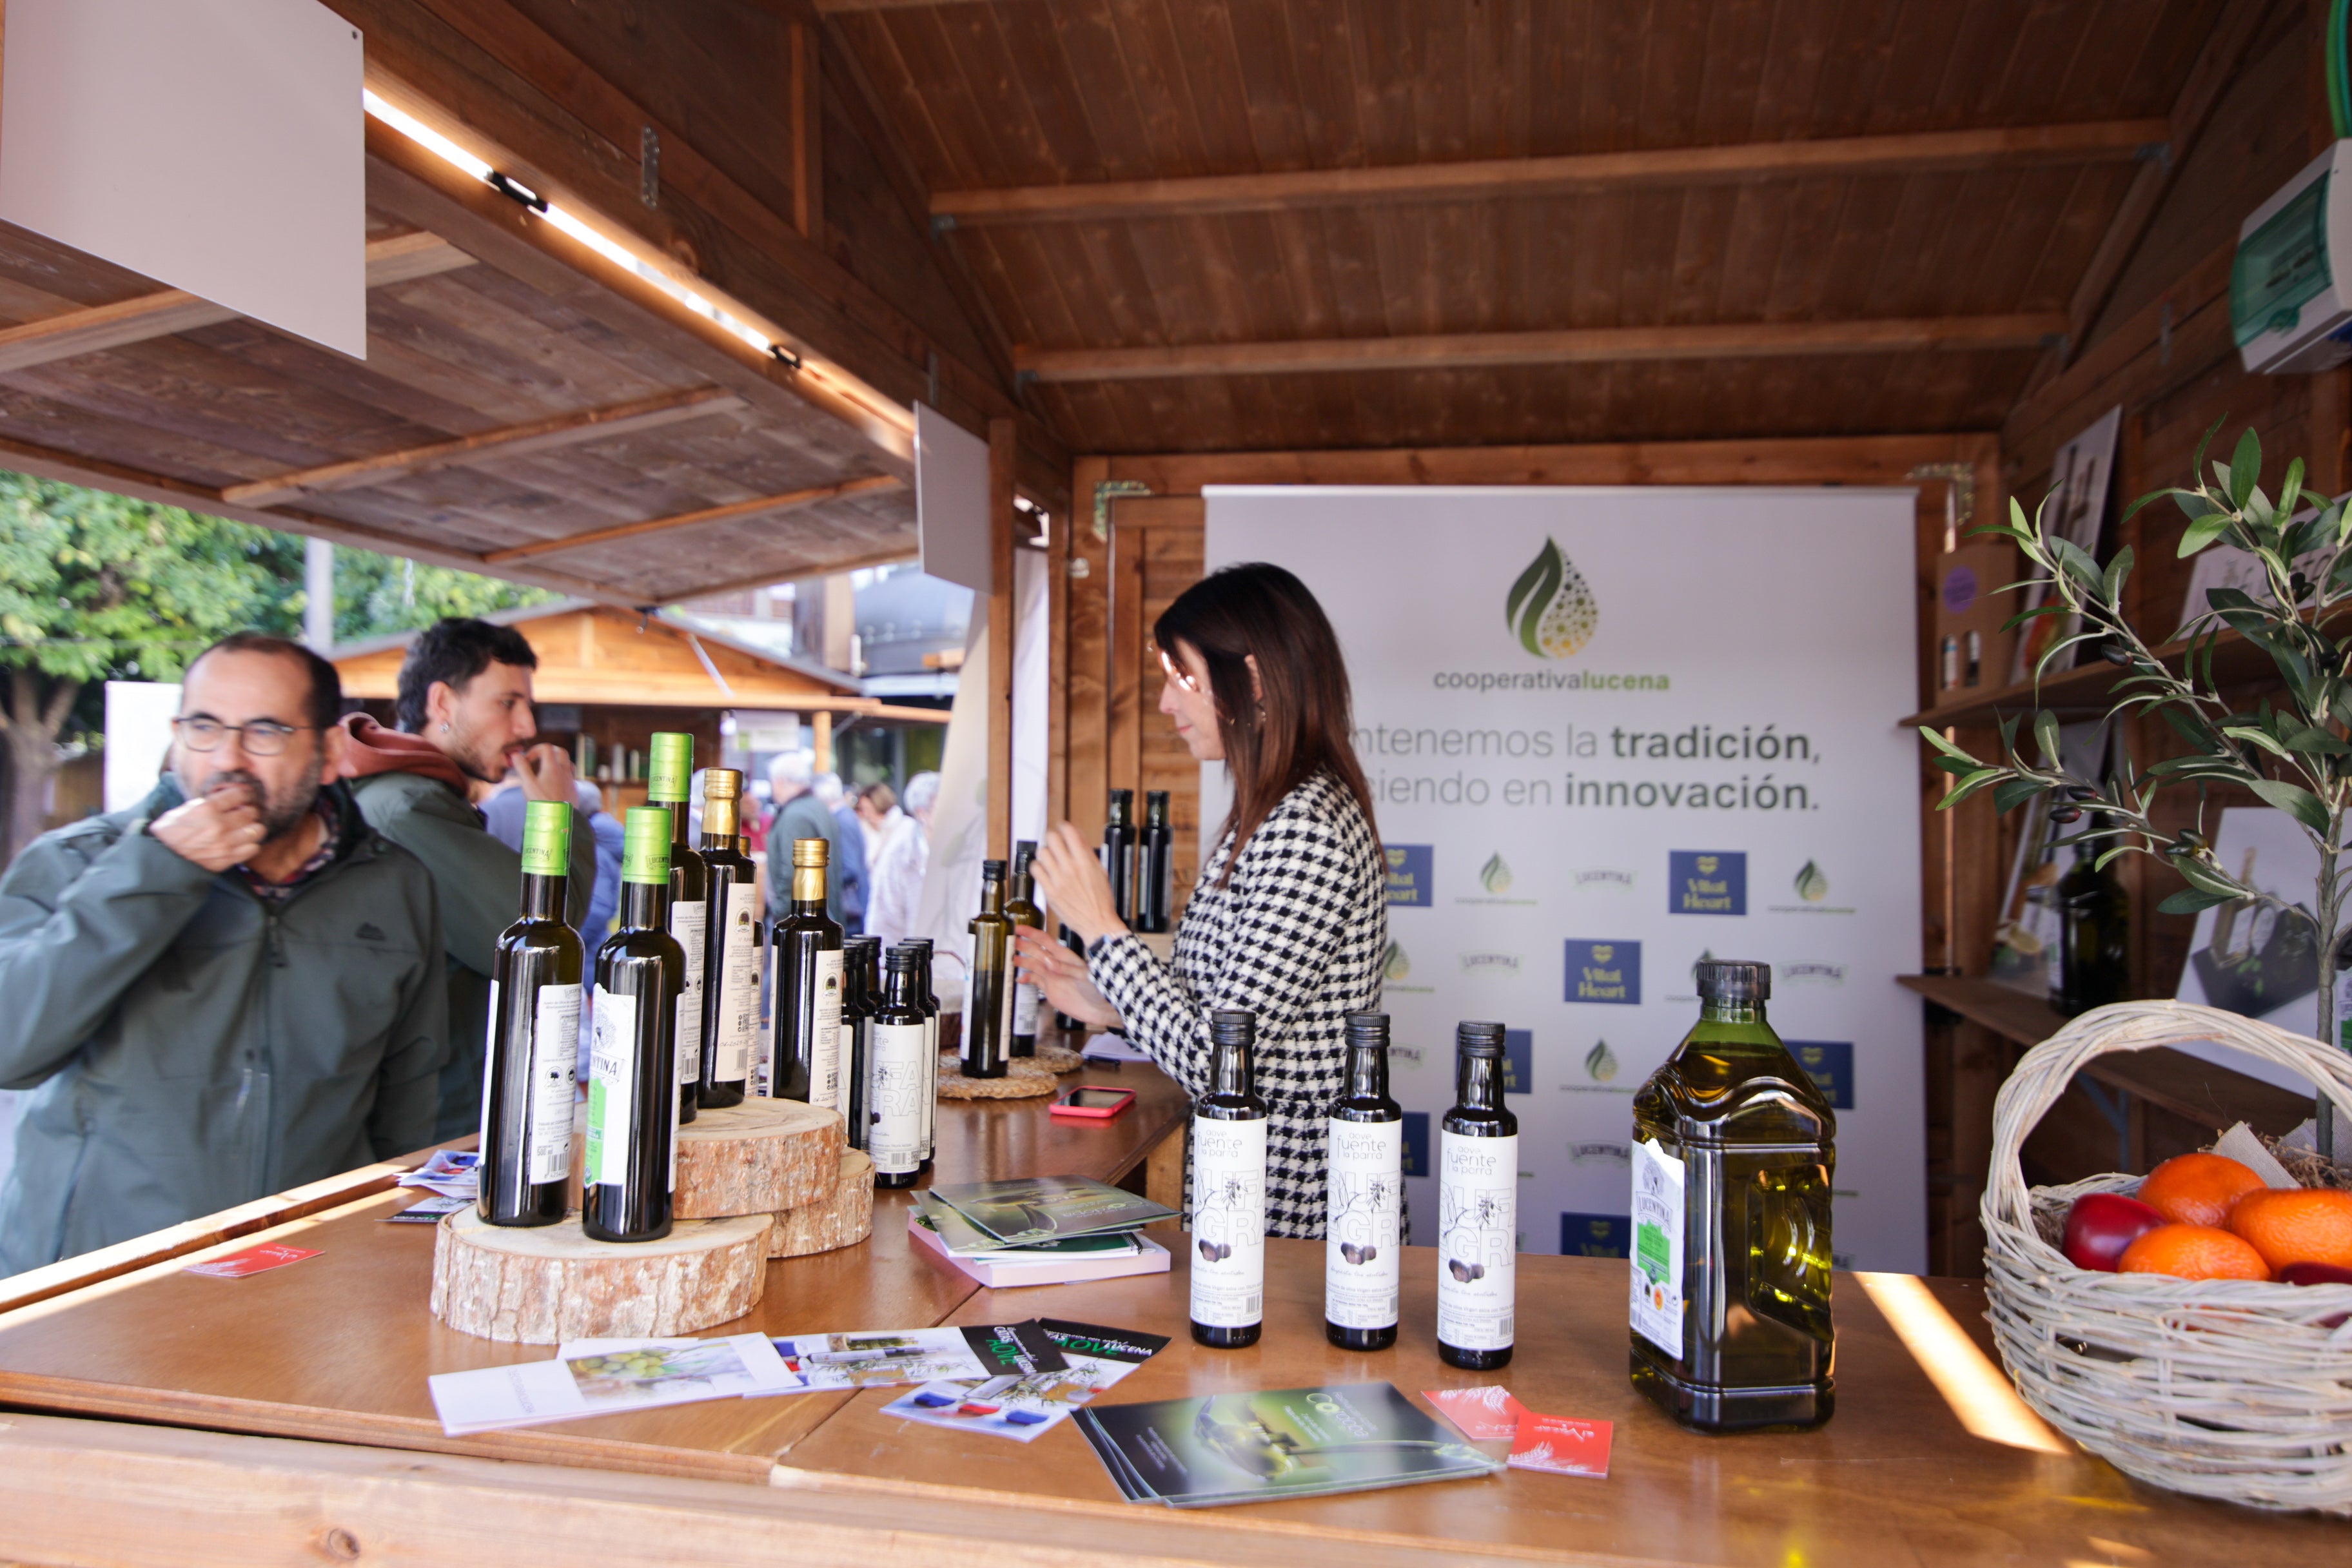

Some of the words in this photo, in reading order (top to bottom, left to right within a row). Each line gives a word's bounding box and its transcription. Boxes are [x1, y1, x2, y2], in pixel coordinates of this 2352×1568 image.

[1433, 669, 1671, 692] cooperativalucena
[1353, 723, 1554, 757] ntenemos
[1567, 723, 1598, 757] la
[1612, 724, 1822, 764] tradición,
[1503, 780, 1552, 807] en
[1565, 771, 1820, 812] innovación.
[1387, 872, 1415, 885] ital
[1687, 879, 1727, 894] Vital
[1386, 887, 1418, 901] eart
[1683, 893, 1732, 910] Heart
[1462, 954, 1520, 969] LUCENTINA
[1582, 966, 1622, 983] Vital
[1578, 982, 1626, 999] Heart
[591, 1055, 619, 1076] NTINA
[1197, 1131, 1242, 1155] fuente
[1337, 1134, 1387, 1159] fuente
[1353, 1152, 1383, 1161] parra
[1447, 1147, 1496, 1171] fuente
[1461, 1166, 1493, 1175] parra
[1638, 1195, 1671, 1223] LUCENTINA
[993, 1326, 1014, 1344] CATAS
[985, 1338, 1019, 1367] AOVE
[1103, 1342, 1153, 1357] LUCENA
[1013, 1355, 1038, 1375] LUCENA
